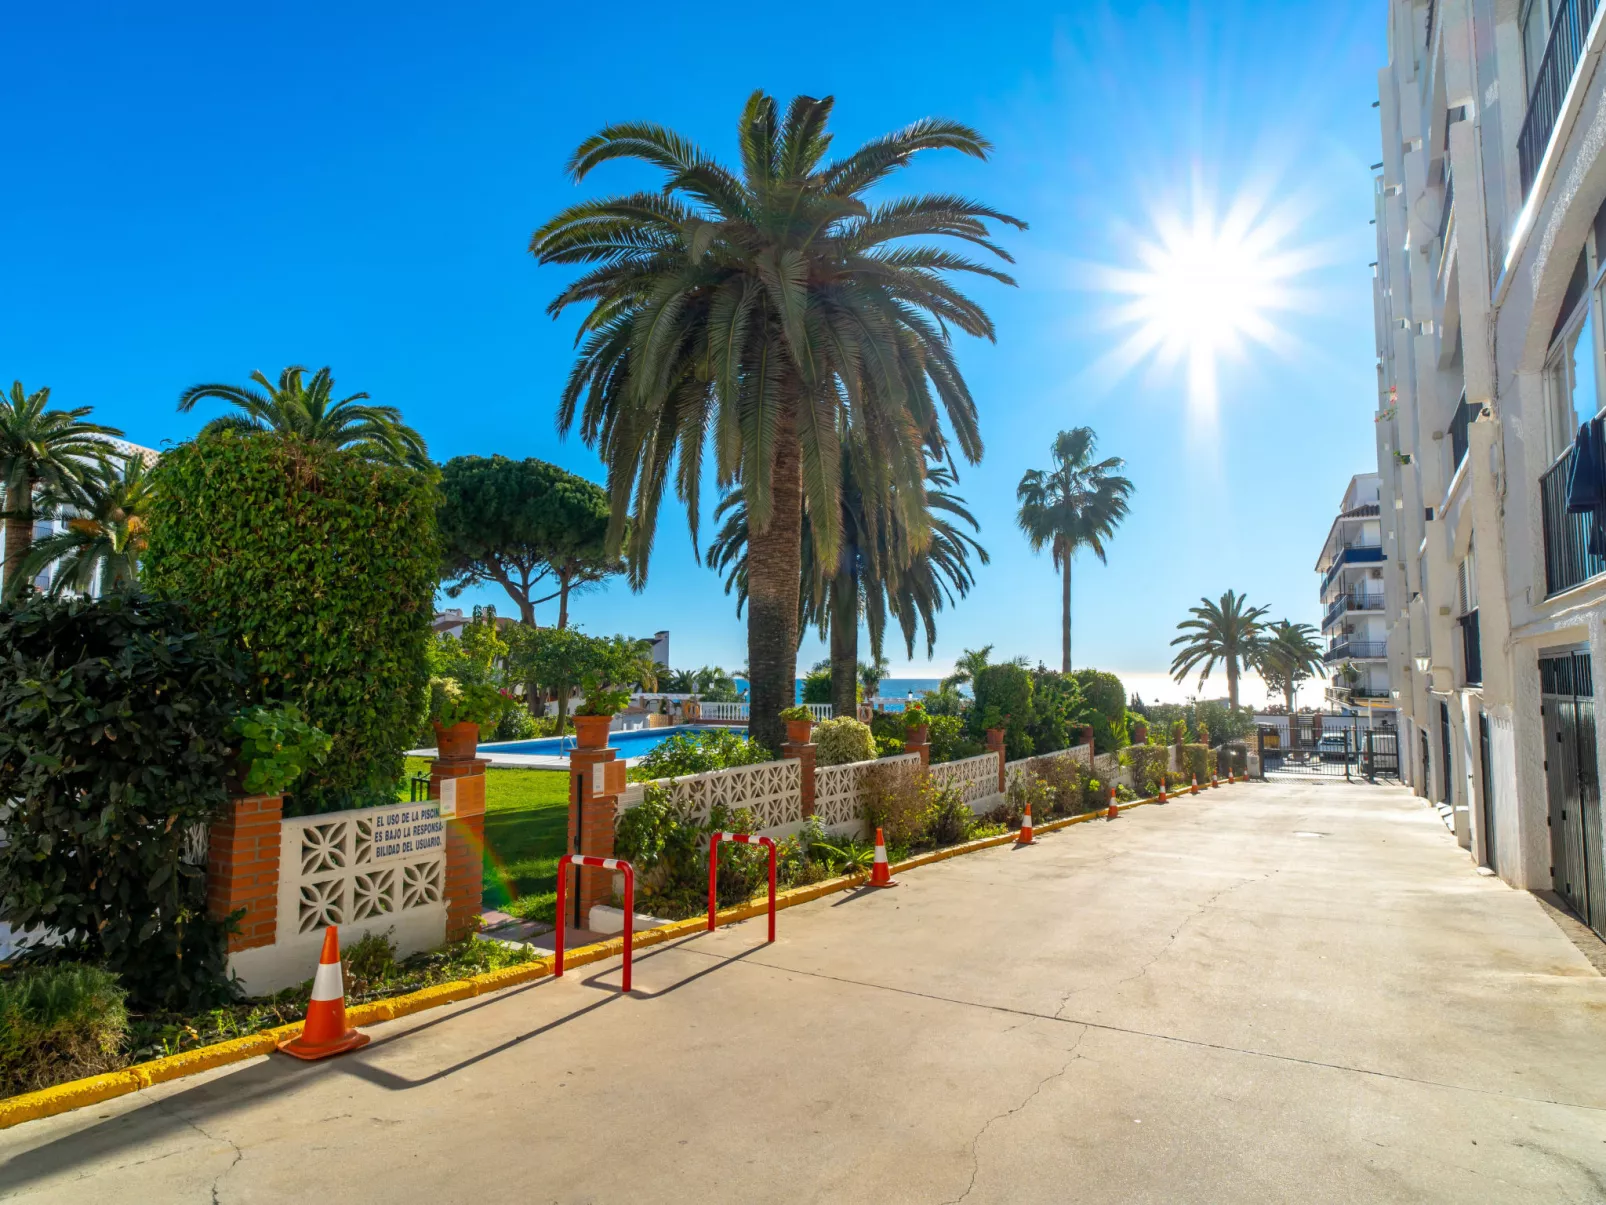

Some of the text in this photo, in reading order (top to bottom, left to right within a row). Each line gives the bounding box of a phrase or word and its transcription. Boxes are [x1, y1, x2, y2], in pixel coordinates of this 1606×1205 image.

[376, 808, 440, 827] EL USO DE LA PISCIN
[375, 822, 443, 842] ES BAJO LA RESPONSA-
[376, 836, 441, 857] BILIDAD DEL USUARIO.
